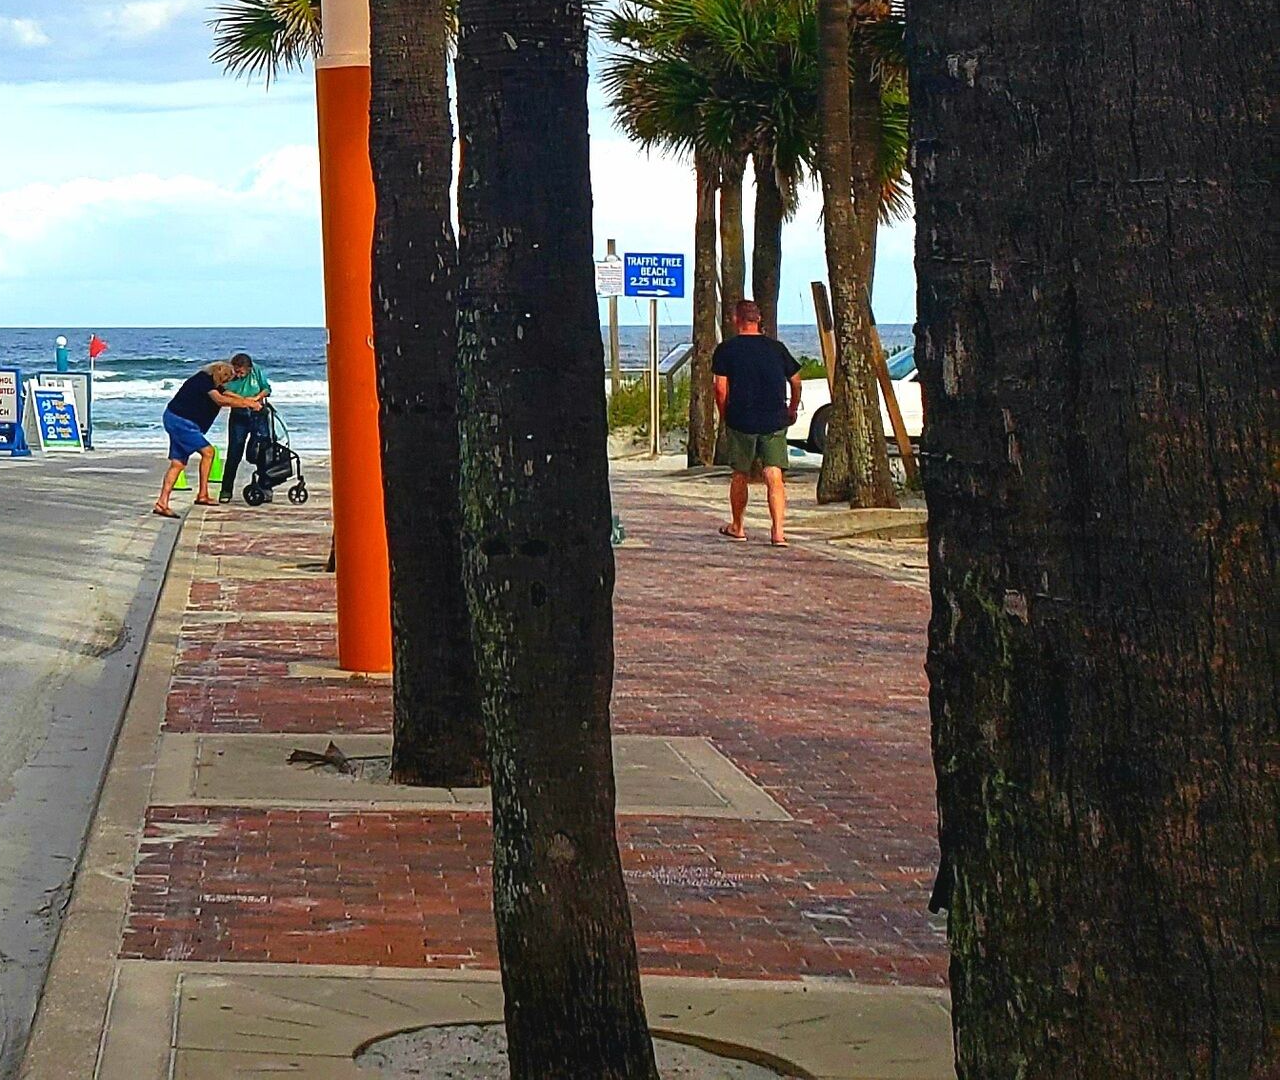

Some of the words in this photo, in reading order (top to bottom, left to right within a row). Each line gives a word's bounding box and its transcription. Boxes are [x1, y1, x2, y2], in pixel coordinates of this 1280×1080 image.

[627, 256, 658, 266] TRAFFIC
[661, 257, 682, 267] FREE
[640, 267, 668, 276] BEACH
[651, 277, 677, 287] MILES
